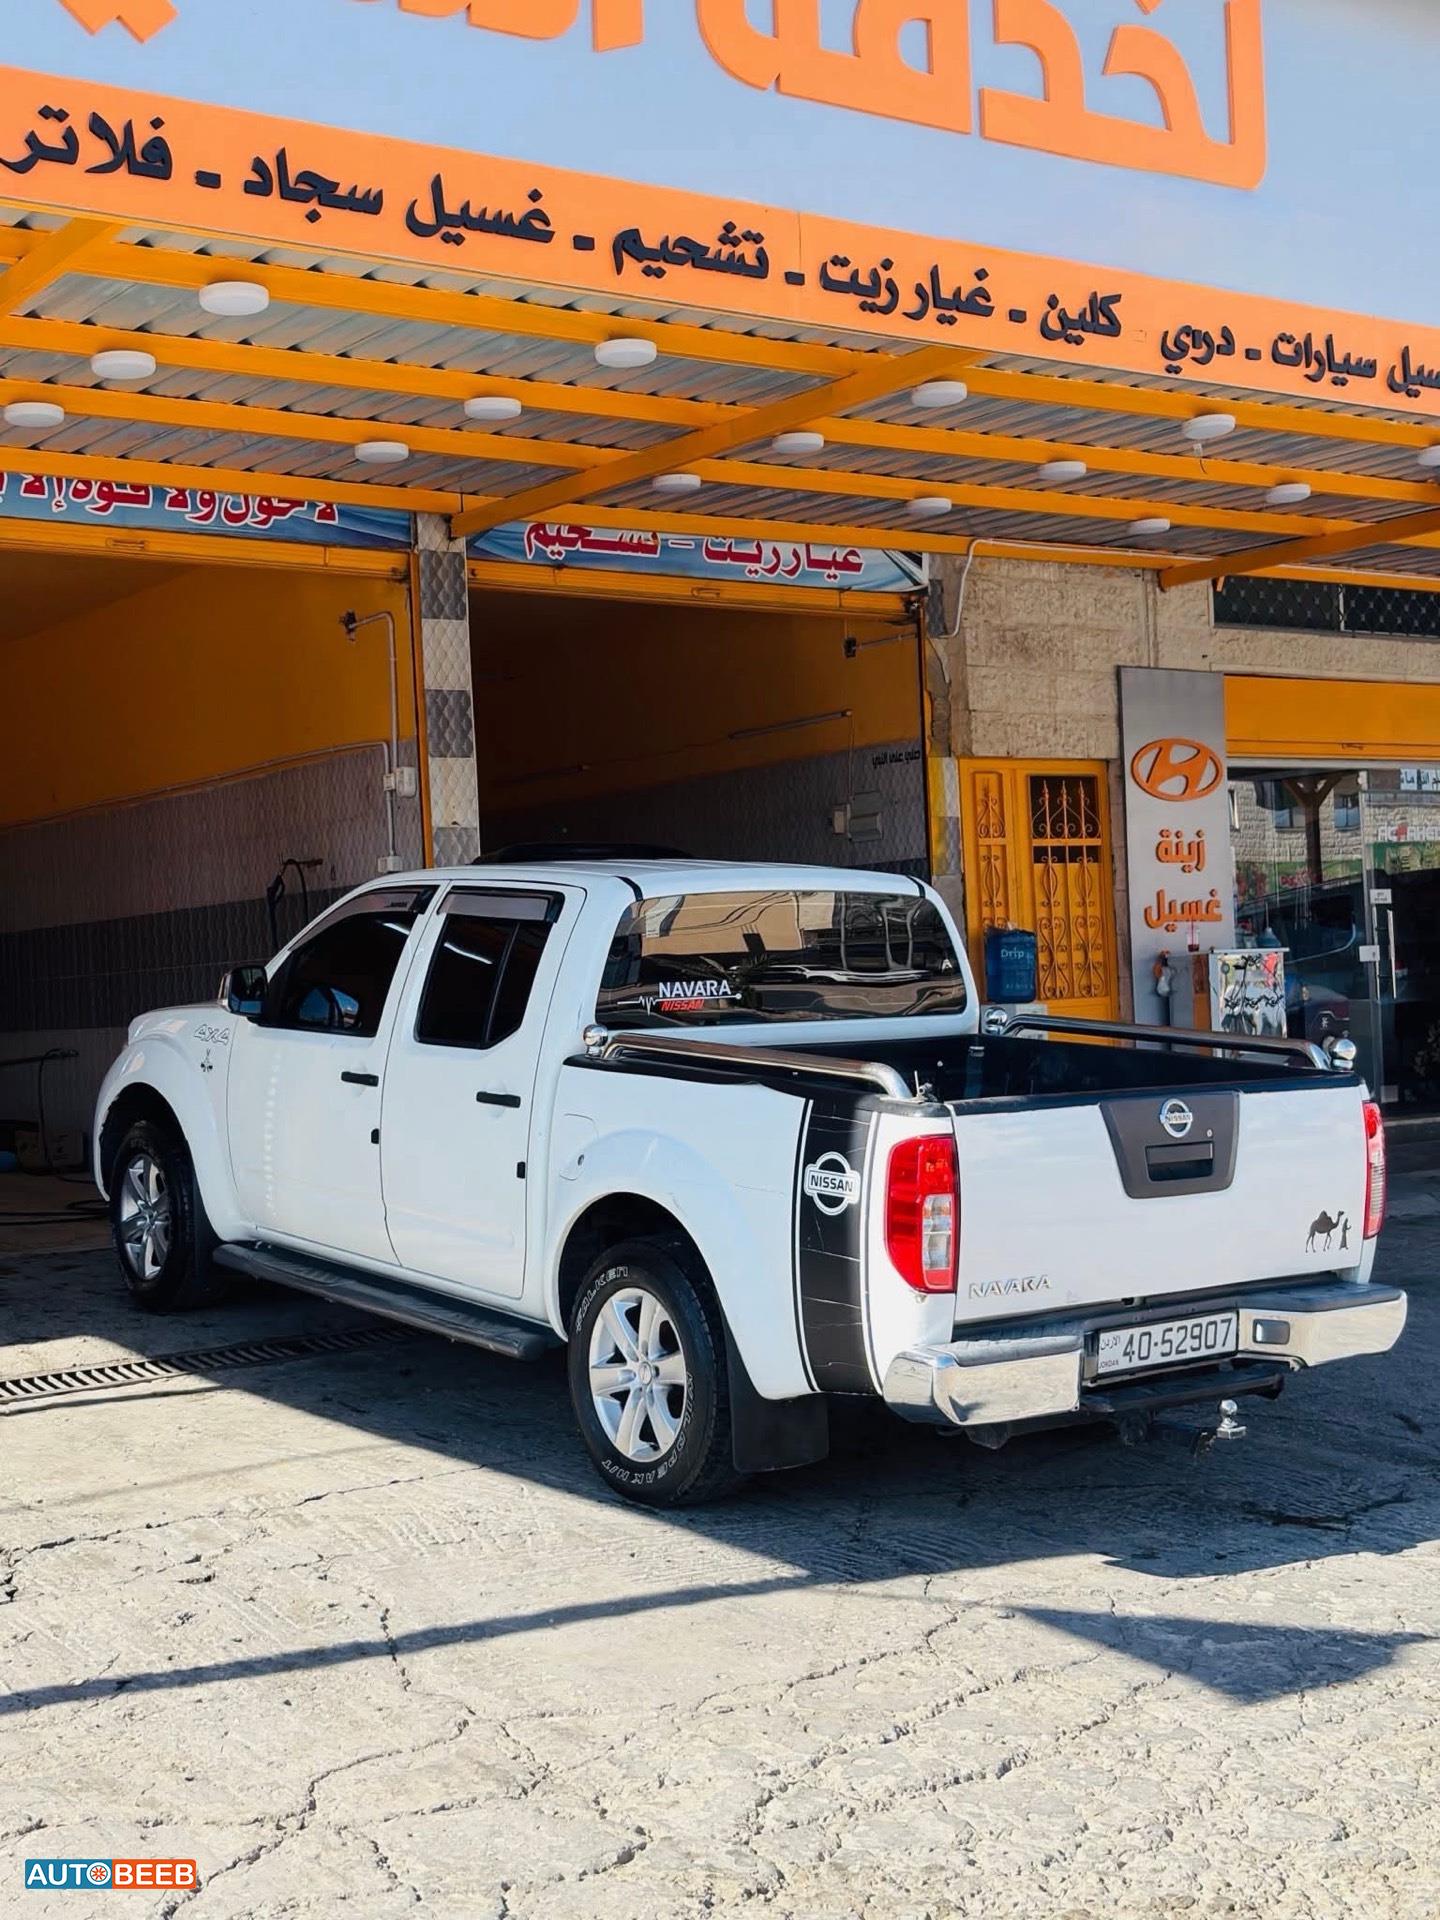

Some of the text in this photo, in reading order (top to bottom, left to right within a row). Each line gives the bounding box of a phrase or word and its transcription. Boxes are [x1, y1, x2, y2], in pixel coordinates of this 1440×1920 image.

[0, 104, 174, 181] فلاتر
[243, 146, 384, 224] سجاد
[405, 172, 556, 248] غسيل
[612, 220, 770, 280] تشحيم
[819, 254, 900, 316] زيت
[902, 263, 996, 326] غيار
[1039, 291, 1123, 346] كلين
[1271, 331, 1378, 388] سيارات
[1155, 828, 1206, 874] زينة
[1144, 888, 1223, 933] غسيل
[658, 980, 732, 998] NAVARA
[661, 999, 704, 1011] NISSAN
[810, 1174, 853, 1193] NISSAN
[575, 1265, 629, 1334] FALKEN
[968, 1274, 1052, 1300] NAVARA
